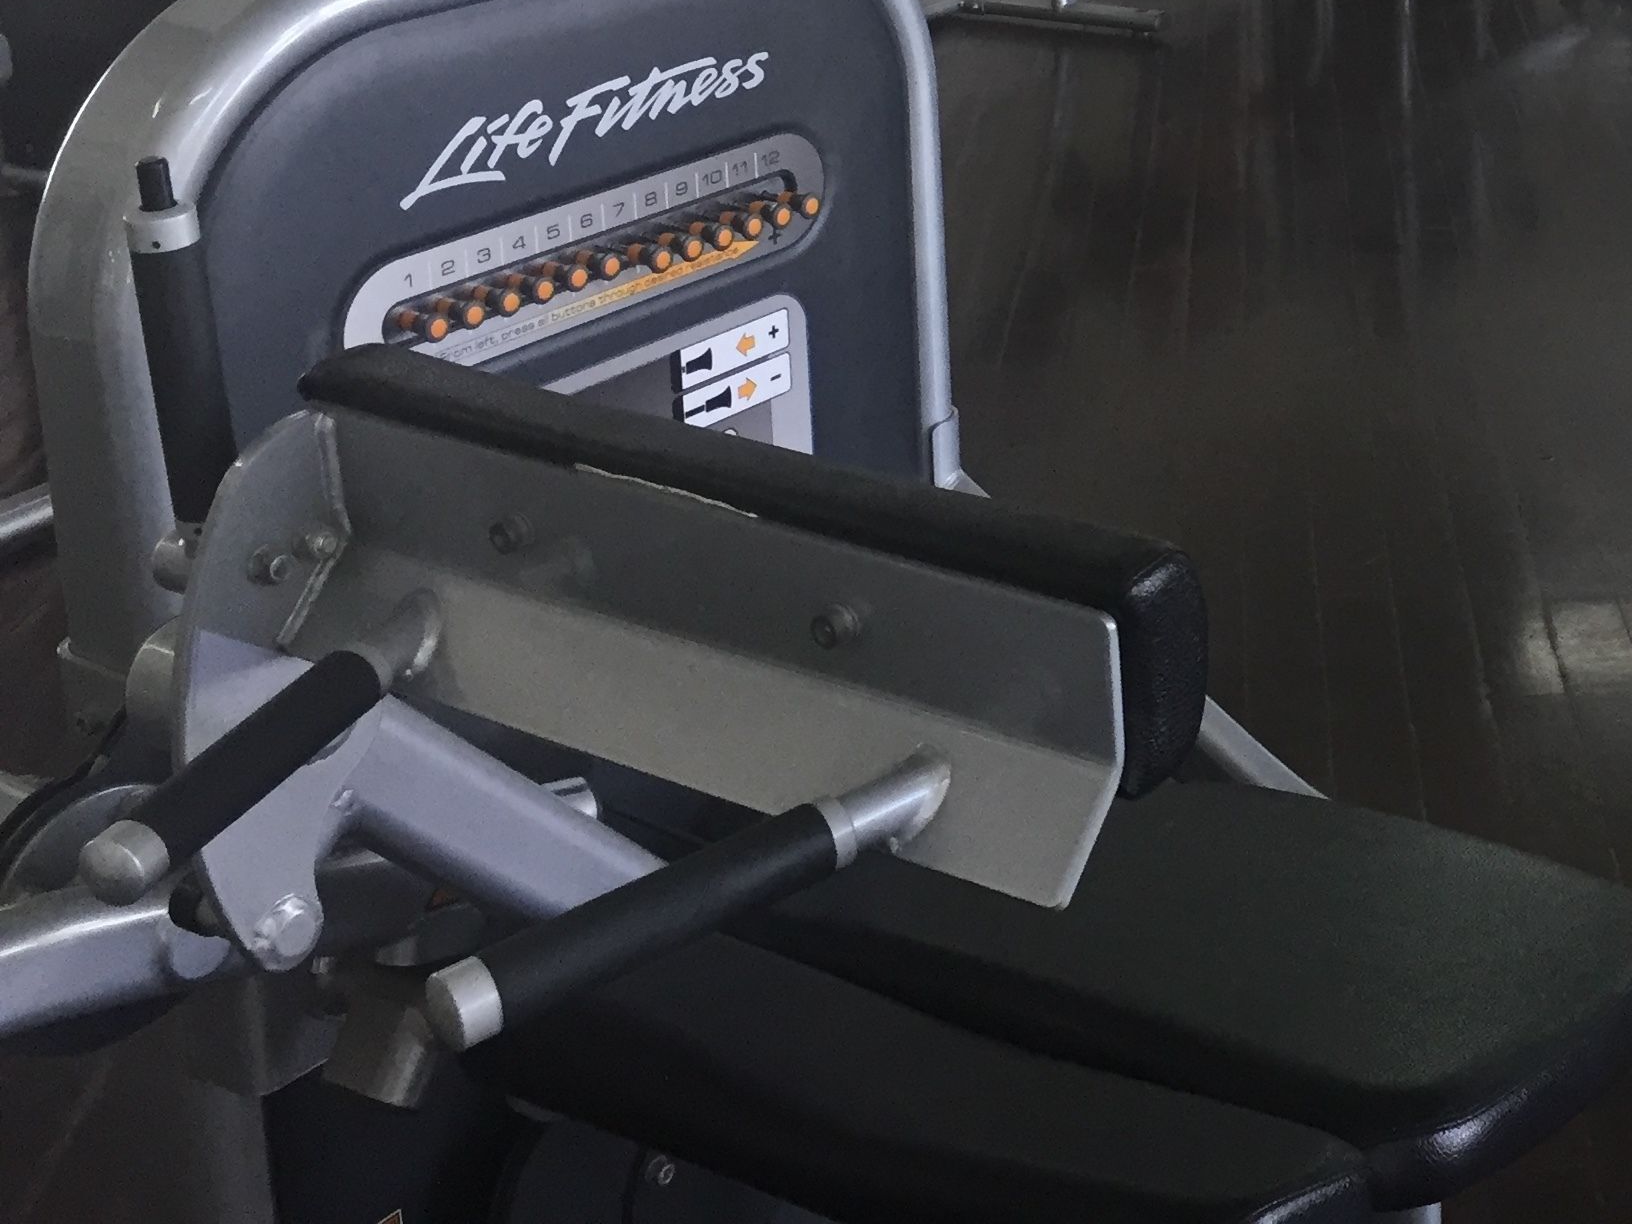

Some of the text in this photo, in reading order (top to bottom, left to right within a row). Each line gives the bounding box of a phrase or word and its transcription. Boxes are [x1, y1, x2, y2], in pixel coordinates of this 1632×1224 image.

[404, 150, 780, 287] 1 2 3 4 5 6 7 8 9 10 11 12
[551, 299, 596, 322] buttons
[598, 281, 643, 305] through
